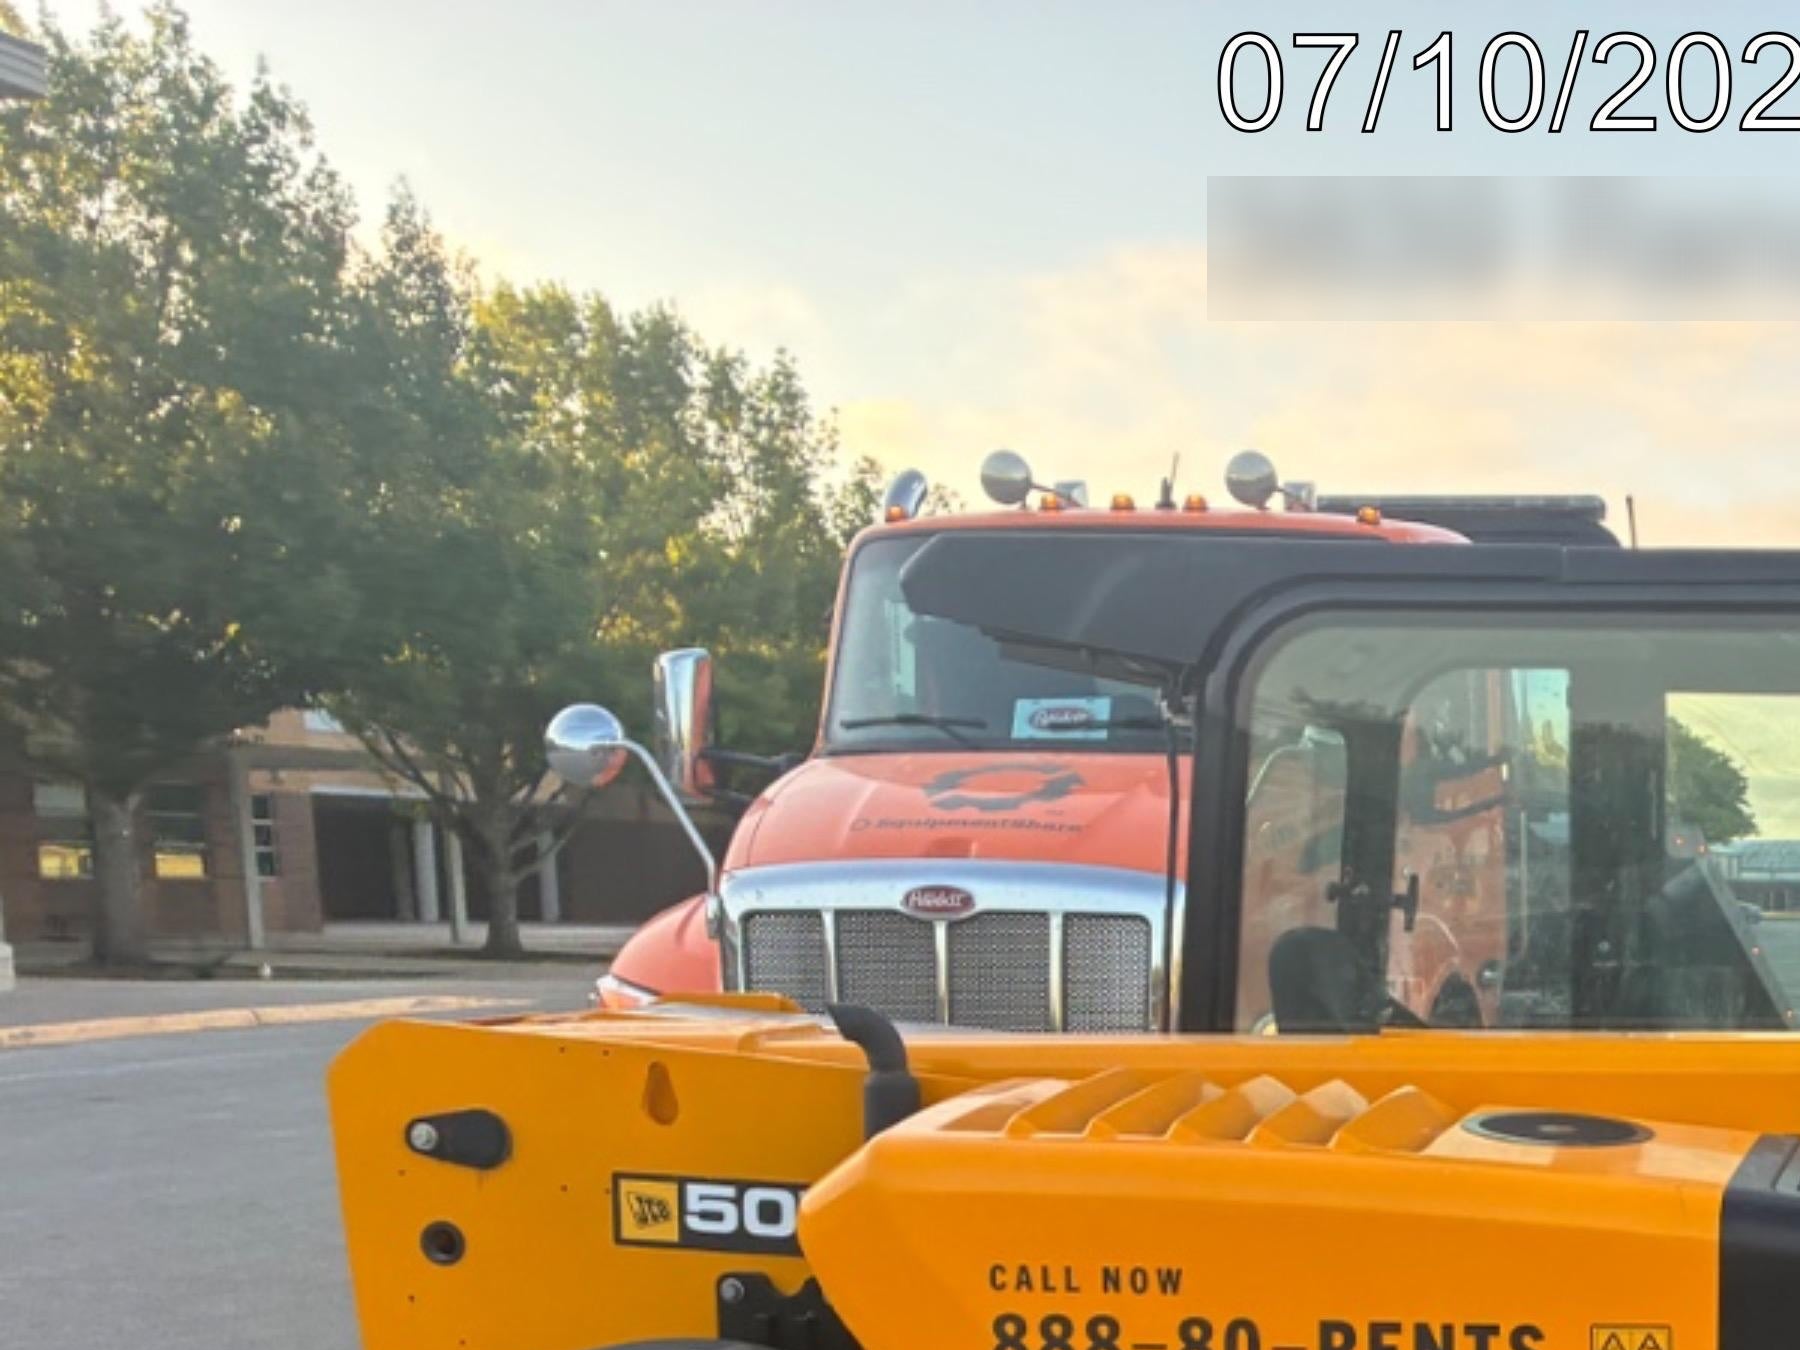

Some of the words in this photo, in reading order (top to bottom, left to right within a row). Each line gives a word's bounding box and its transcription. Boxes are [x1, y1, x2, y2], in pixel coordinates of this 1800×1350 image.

[684, 1181, 808, 1238] 50
[989, 1264, 1080, 1293] CALL
[1101, 1266, 1183, 1295] NOW
